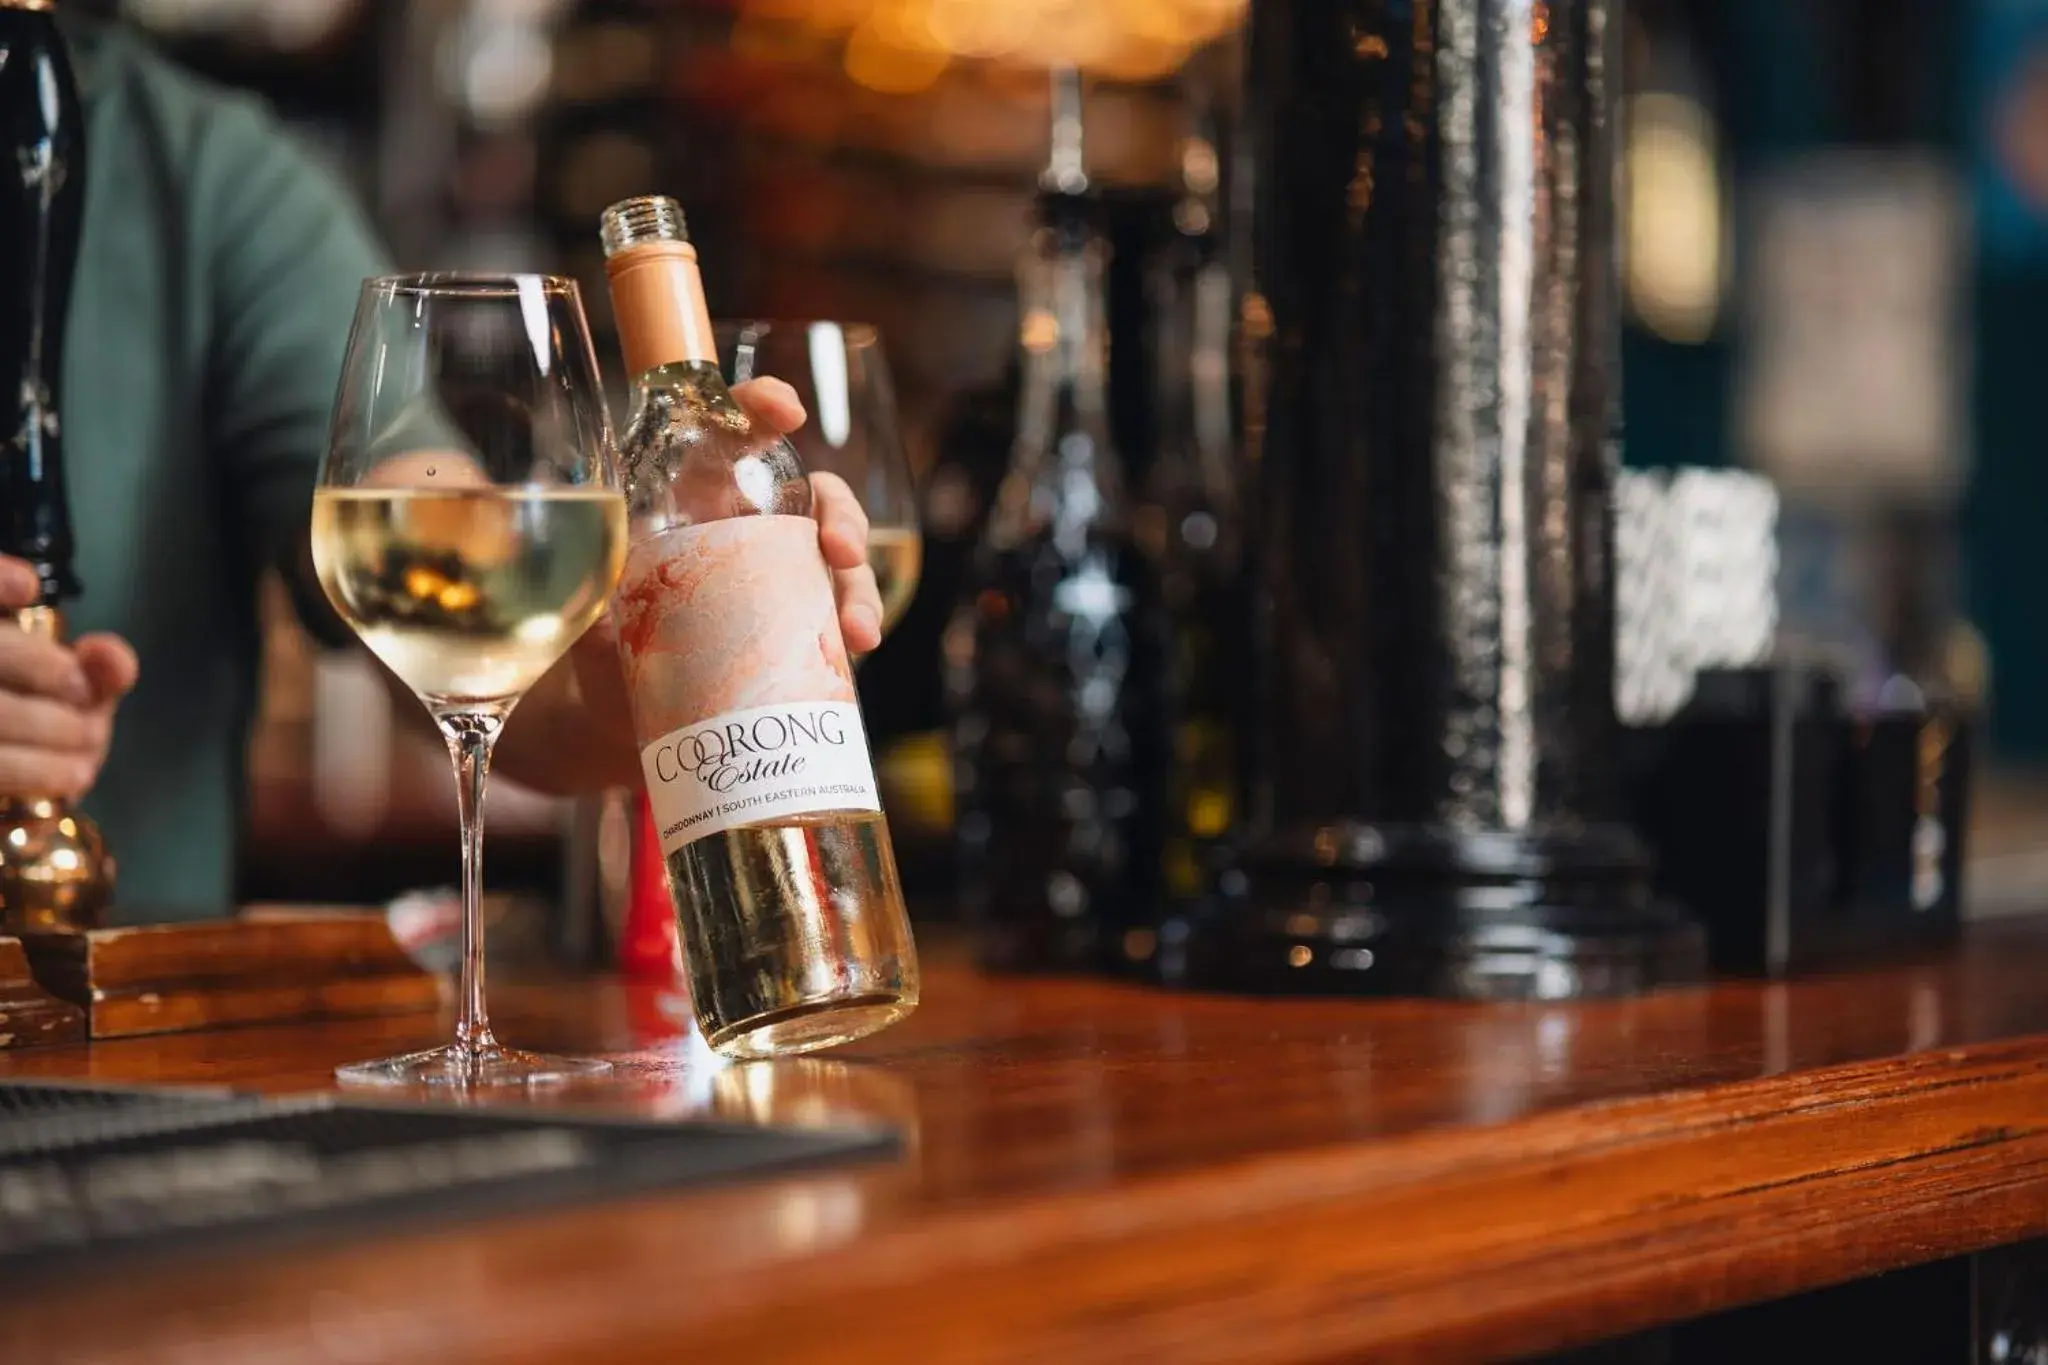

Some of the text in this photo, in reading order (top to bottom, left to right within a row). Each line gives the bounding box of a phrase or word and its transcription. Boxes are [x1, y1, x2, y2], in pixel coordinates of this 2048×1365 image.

[656, 710, 845, 782] COORONG
[696, 750, 807, 793] Estate
[722, 796, 762, 813] SOUTH
[766, 786, 816, 803] EASTERN
